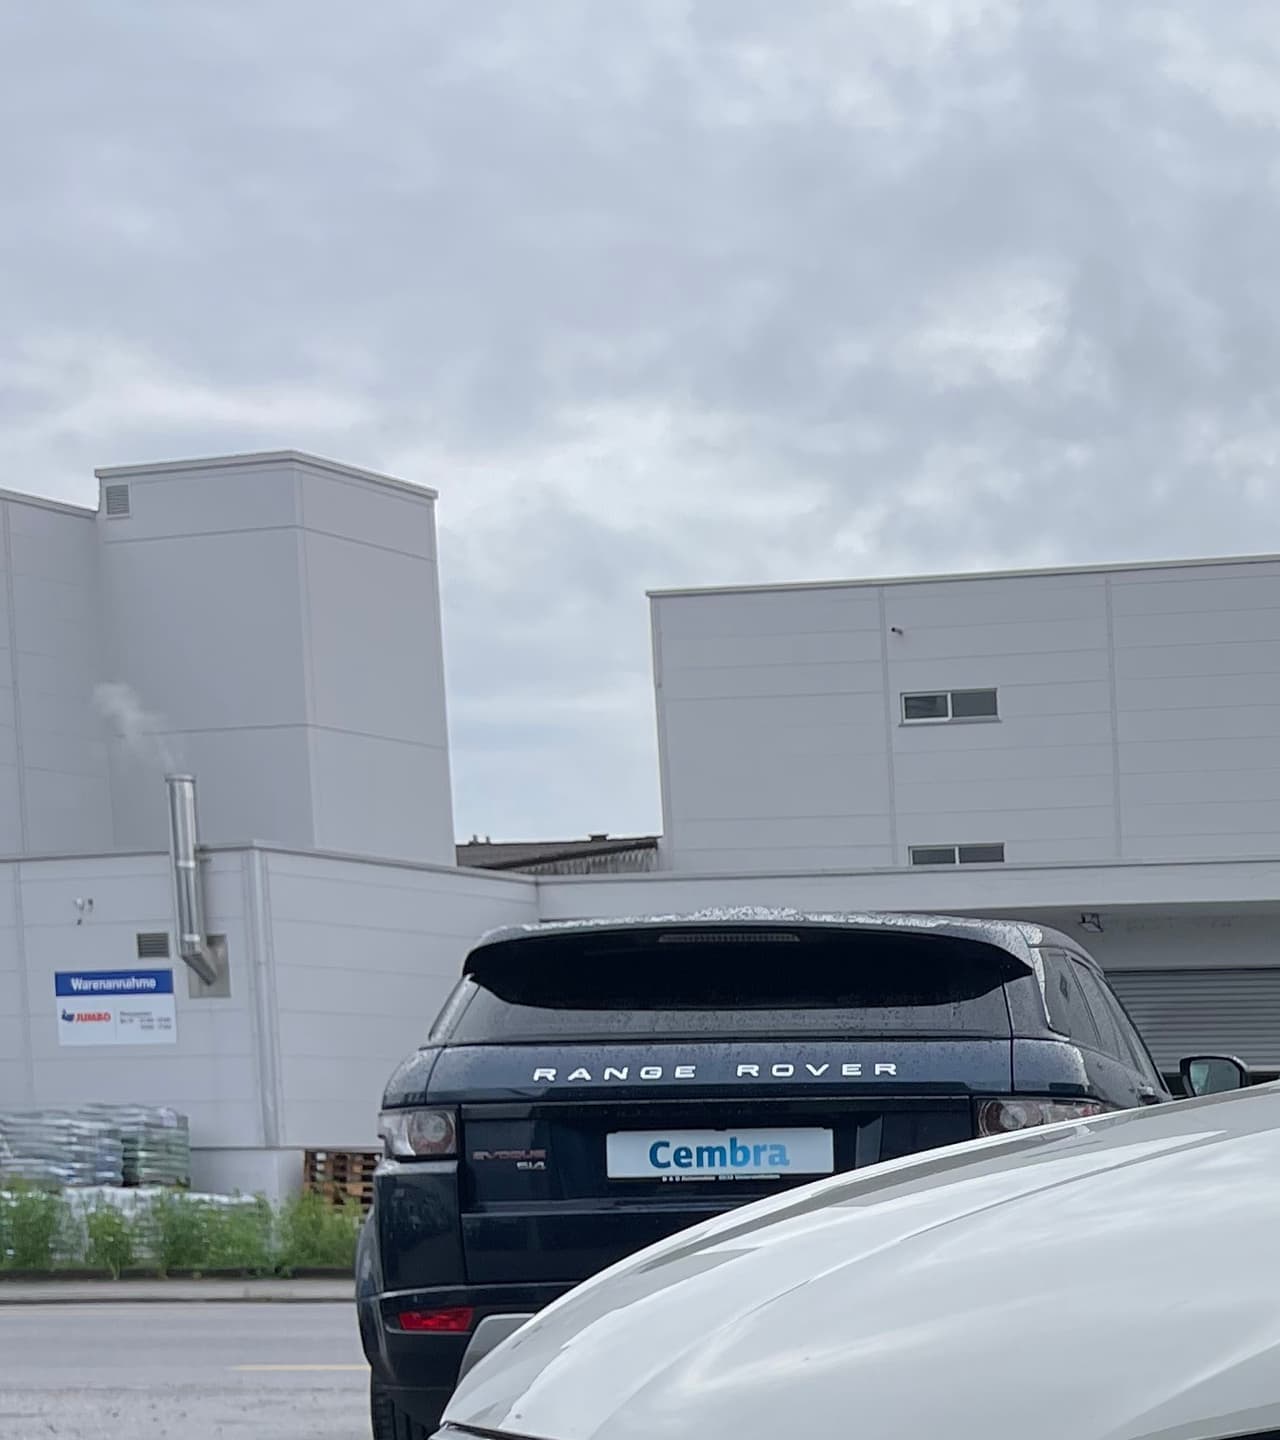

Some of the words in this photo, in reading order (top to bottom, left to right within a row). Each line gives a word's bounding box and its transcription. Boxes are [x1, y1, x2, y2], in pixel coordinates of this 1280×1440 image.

[71, 976, 157, 991] Warenannahme
[75, 1012, 112, 1023] JUMBO
[533, 1065, 697, 1082] RANGE
[736, 1063, 897, 1078] ROVER
[649, 1137, 790, 1169] Cembra
